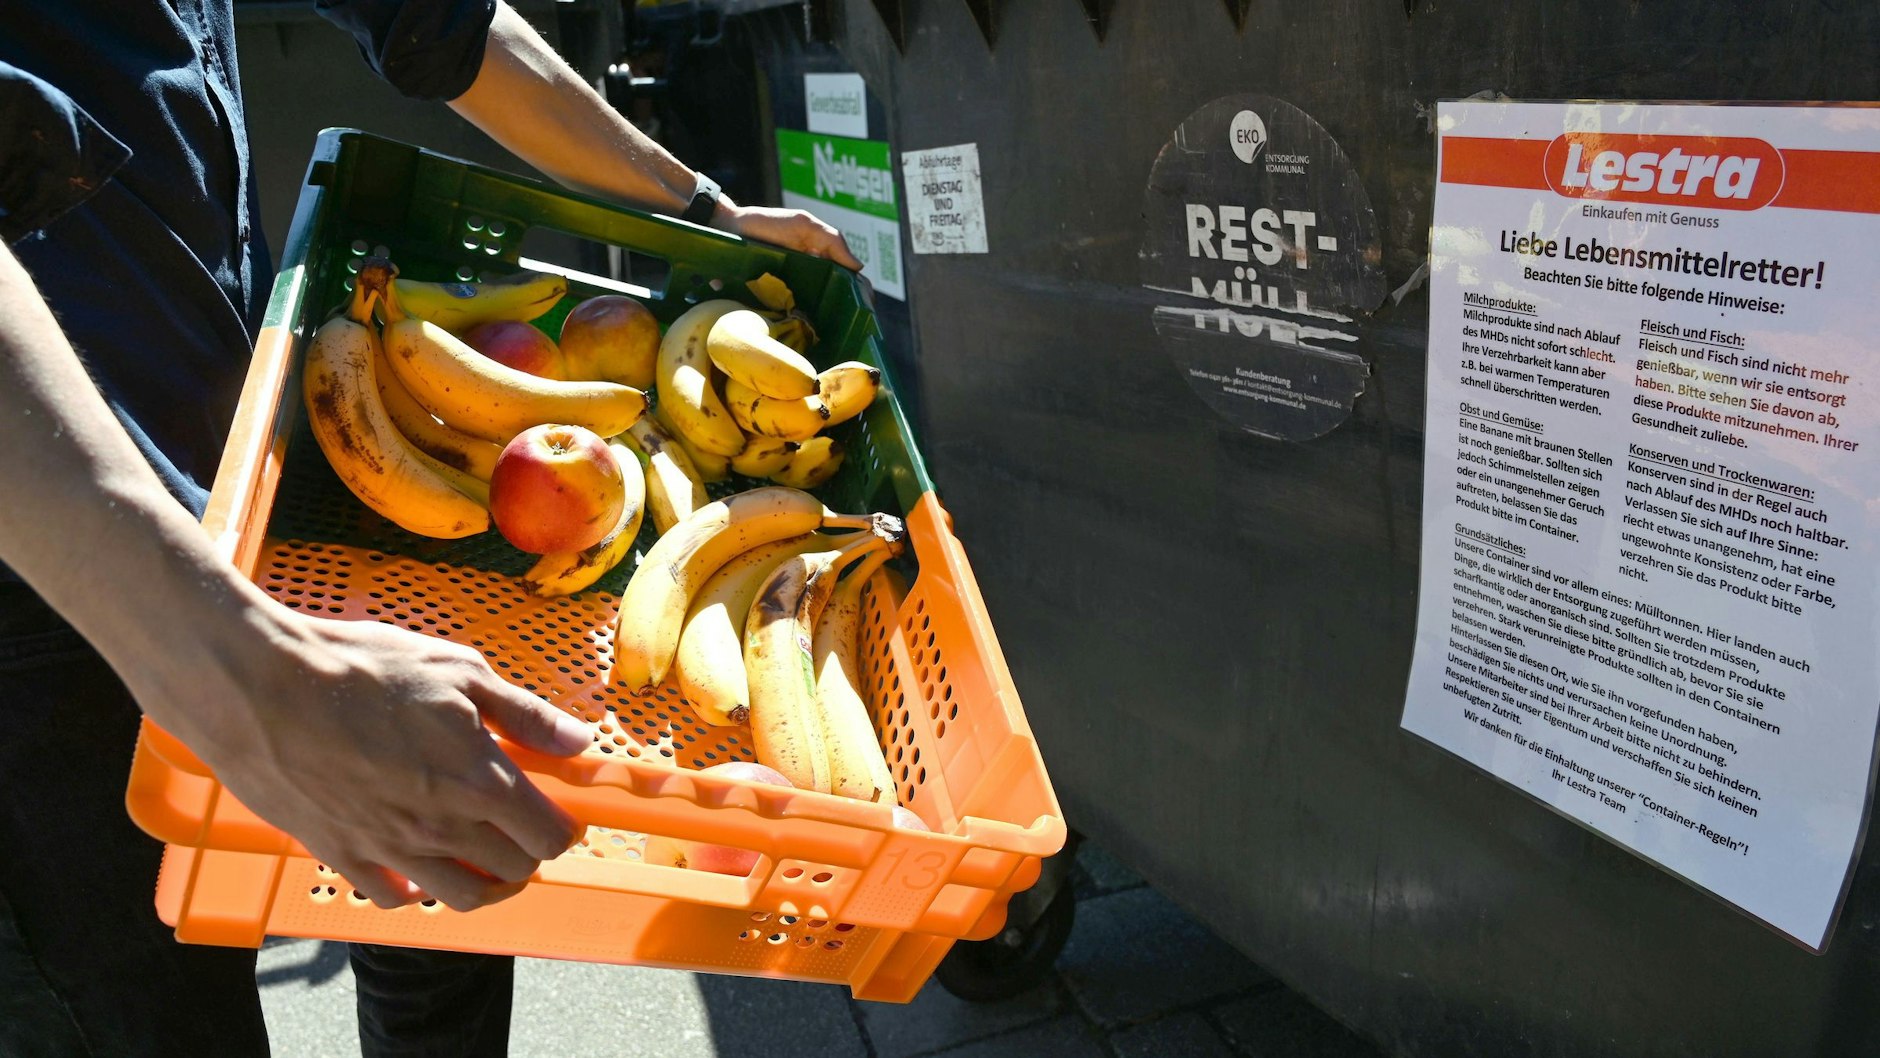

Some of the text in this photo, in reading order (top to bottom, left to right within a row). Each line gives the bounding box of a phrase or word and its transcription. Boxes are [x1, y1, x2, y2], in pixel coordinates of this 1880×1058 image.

[1237, 130, 1259, 143] EKO
[1265, 154, 1310, 164] ENTSORGUNG
[1266, 164, 1306, 174] KOMMUNAL
[1560, 143, 1760, 200] Lestra
[922, 180, 962, 196] DIENSTAG
[934, 198, 953, 211] UND
[930, 213, 962, 227] FREITAG
[1186, 204, 1337, 270] REST-
[1583, 205, 1719, 228] Einkaufen mit Genuss
[1501, 230, 1824, 289] Liebe Lebensmittelretter!
[1464, 292, 1536, 312] Milchprodukte:
[1524, 267, 1784, 315] Beachten Sie bitte folgende Hinweise:
[1463, 325, 1615, 363] des MHDs nicht sofort schlecht.
[1464, 309, 1621, 345] Milchprodukte sind nach Ablauf
[1640, 320, 1745, 346] Fleisch und Fisch:
[1190, 368, 1208, 378] Telefon
[1236, 367, 1291, 389] Kundenberatung
[1462, 342, 1606, 379] Ihre Verzehrbarkeit kann aber
[1462, 360, 1610, 399] z.B. bei warmen Temperaturen
[1639, 338, 1849, 384] Fleisch und Fisch sind nicht mehr
[1461, 376, 1601, 415] schnell überschritten werden.
[1635, 375, 1839, 429] haben. Bitte sehen Sie davon ab,
[1636, 360, 1846, 408] genießbar, wenn wir sie entsorgt
[1460, 402, 1543, 431] Obst und Gemüse:
[1632, 413, 1747, 448] Gesundheit zuliebe.
[1634, 394, 1859, 452] diese Produkte mitzunehmen. Ihrer
[1459, 433, 1602, 481] ist noch genießbar. Sollten sich
[1460, 418, 1612, 466] Eine Banane mit braunen Stellen
[1457, 449, 1600, 498] jedoch Schimmelstellen zeigen
[1457, 466, 1604, 517] oder ein unangenehmer Geruch
[1628, 461, 1827, 523] Konserven sind in der Regel auch
[1629, 443, 1814, 499] Konserven und Trockenwaren:
[1456, 482, 1577, 525] auftreten, belassen Sie das
[1456, 495, 1579, 543] Produkt bitte im Container.
[1627, 480, 1848, 549] nach Ablauf des MHDs noch haltbar.
[1455, 523, 1526, 555] Grundsätzliches:
[1625, 495, 1818, 561] Verlassen Sie sich auf Ihre Sinne:
[1619, 565, 1648, 582] nicht.
[1455, 537, 1810, 672] Unsere Container sind vor allem eines: Mülltonnen. Hier landen auch
[1443, 682, 1522, 725] unbefugten Zutritt.
[1464, 709, 1479, 723] Wir
[1480, 718, 1512, 739] danken
[1514, 733, 1527, 746] für
[1529, 741, 1543, 755] die
[1545, 748, 1595, 782] Einhaltung
[1597, 776, 1636, 799] unserer
[1552, 769, 1626, 813] Ihr Lestra Team
[881, 848, 946, 890] 13
